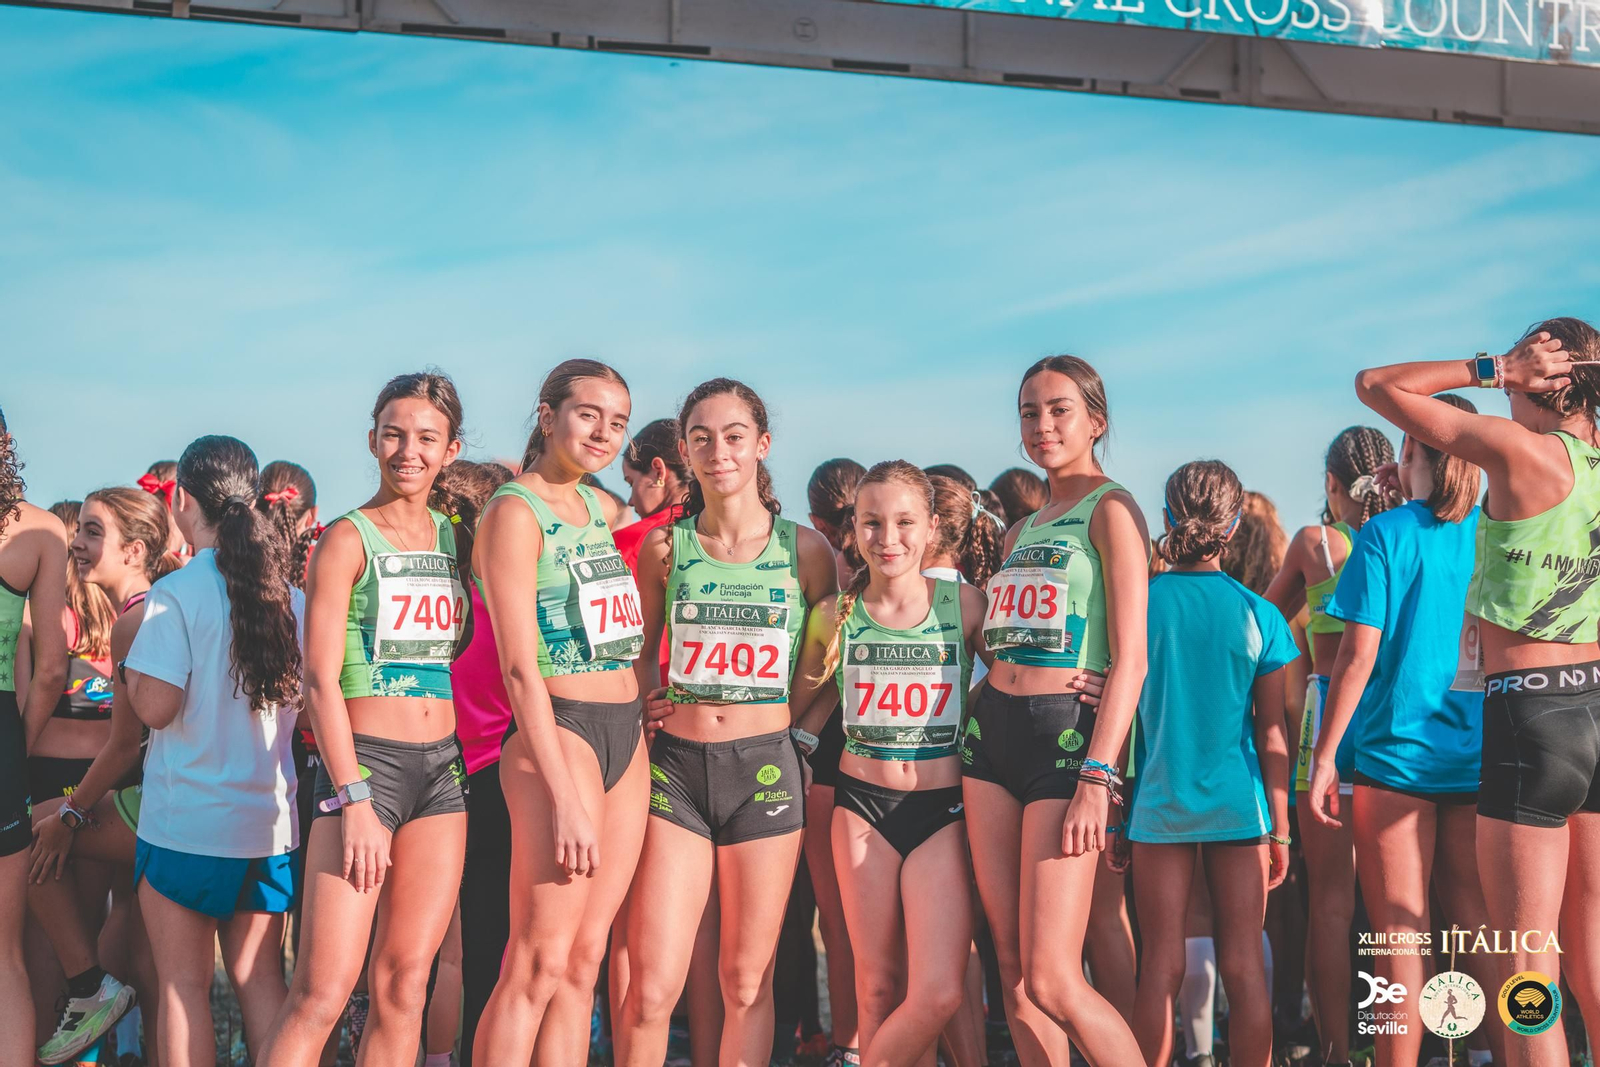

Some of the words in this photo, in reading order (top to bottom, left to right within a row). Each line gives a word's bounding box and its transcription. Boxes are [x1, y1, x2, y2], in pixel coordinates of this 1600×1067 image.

[409, 554, 449, 570] ITÁLICA
[1505, 549, 1531, 566] #I
[720, 590, 751, 598] Unicaja
[989, 584, 1058, 620] 7403
[391, 595, 464, 631] 7404
[590, 592, 643, 633] 7401
[704, 605, 760, 620] ITÁLICA
[682, 641, 780, 679] 7402
[876, 644, 931, 659] ITÁLICA
[1486, 673, 1549, 697] PRO
[854, 683, 953, 718] 7407
